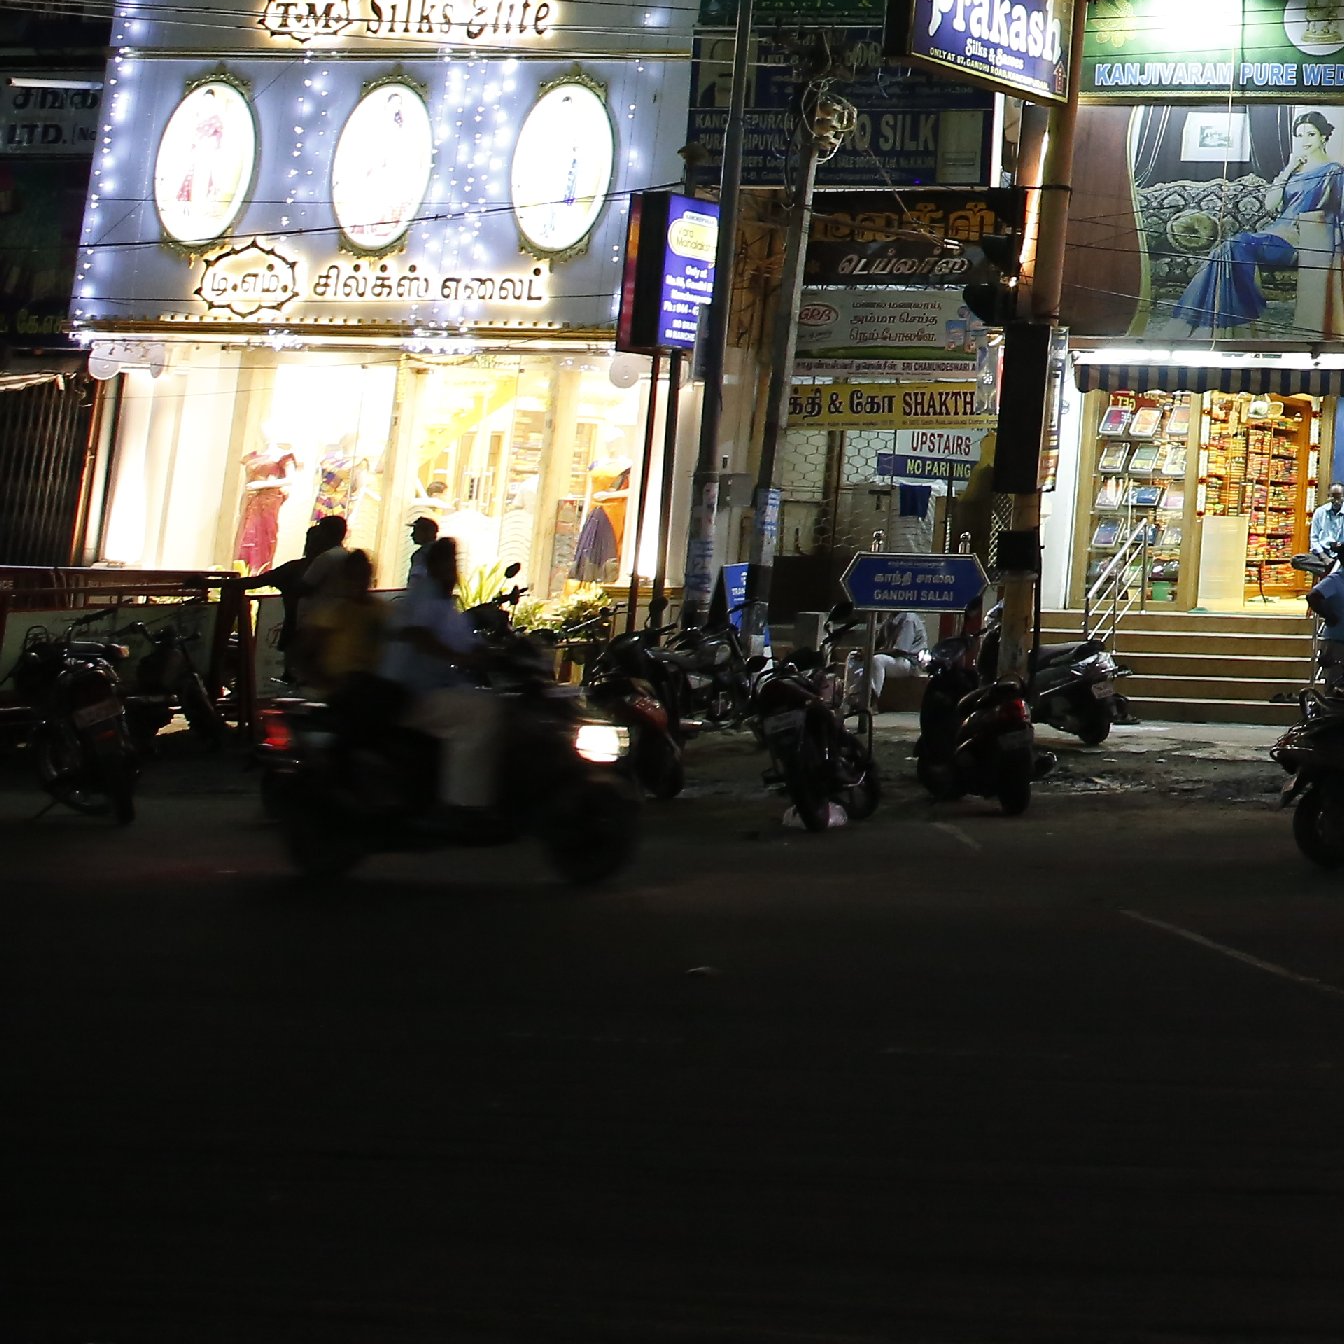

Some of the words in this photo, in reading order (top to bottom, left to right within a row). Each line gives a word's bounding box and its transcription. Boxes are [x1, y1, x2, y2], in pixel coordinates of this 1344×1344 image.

[1095, 63, 1233, 85] KANJIVARAM
[1239, 63, 1297, 86] PURE
[6, 123, 67, 145] LTD.
[879, 114, 936, 151] SILK
[313, 263, 429, 299] சில்க்ஸ்
[441, 267, 543, 301] எலைட்
[828, 392, 843, 414] &
[850, 389, 896, 414] கோ
[902, 391, 980, 416] SHAKTH
[911, 431, 971, 455] UPSTAIRS
[906, 458, 922, 475] NO
[874, 572, 913, 586] காந்தி
[873, 590, 918, 601] GANDHI
[920, 590, 954, 603] SALAI
